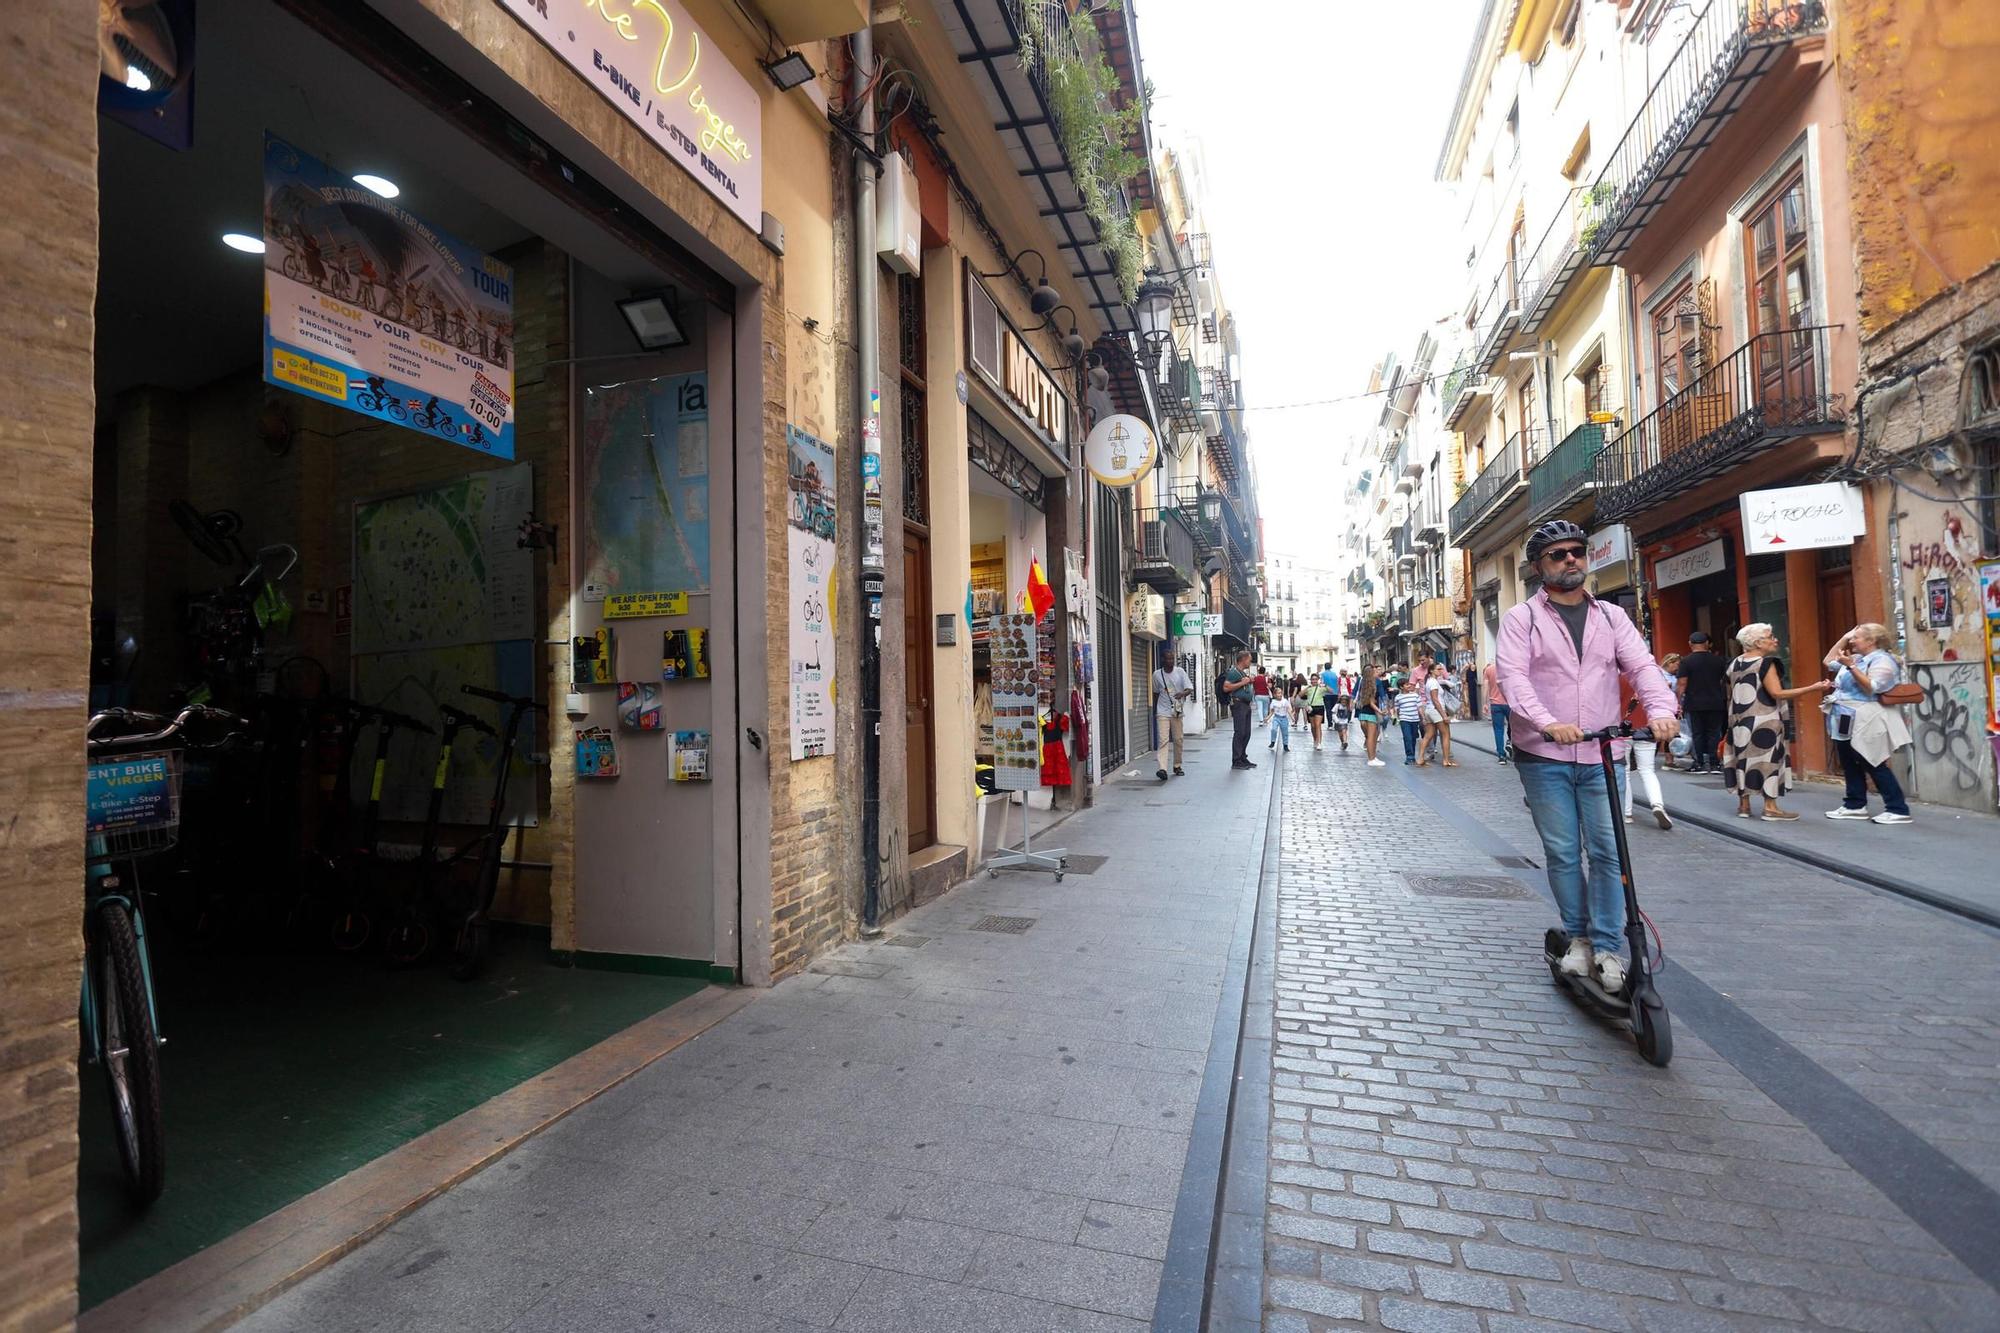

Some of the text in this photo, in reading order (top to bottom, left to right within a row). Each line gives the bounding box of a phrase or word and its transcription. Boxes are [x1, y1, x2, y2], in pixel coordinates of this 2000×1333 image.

[593, 49, 641, 107] E-BIKE
[656, 110, 698, 158] E-STEP
[700, 152, 739, 199] RENTAL
[344, 188, 400, 218] ADVENTURE
[400, 210, 418, 230] FOR
[416, 224, 437, 244] BIKE
[434, 241, 464, 275] LOVERS
[471, 266, 509, 304] TOUR
[299, 329, 357, 355] OFFICIAL GUIDE
[306, 319, 333, 335] HOURS
[334, 331, 352, 344] TOUR
[320, 296, 485, 373] BOOK YOUR CITY TOUR
[389, 341, 423, 359] HORCHATA
[430, 358, 457, 373] DESSERT
[388, 363, 421, 379] FREE GIFT
[474, 380, 494, 398] DUTCH
[1004, 329, 1062, 442] MOTU
[470, 398, 500, 428] 10:00
[1781, 504, 1843, 522] ROCHE
[1680, 550, 1713, 577] ROCHE
[622, 595, 637, 603] ARE
[638, 594, 657, 602] OPEN
[659, 593, 680, 601] FROM
[1183, 619, 1201, 627] ATM
[87, 763, 162, 780] ENT BIKE
[107, 772, 164, 786] VIRGEN
[91, 800, 122, 810] E-Bike
[129, 794, 161, 806] E-Step
